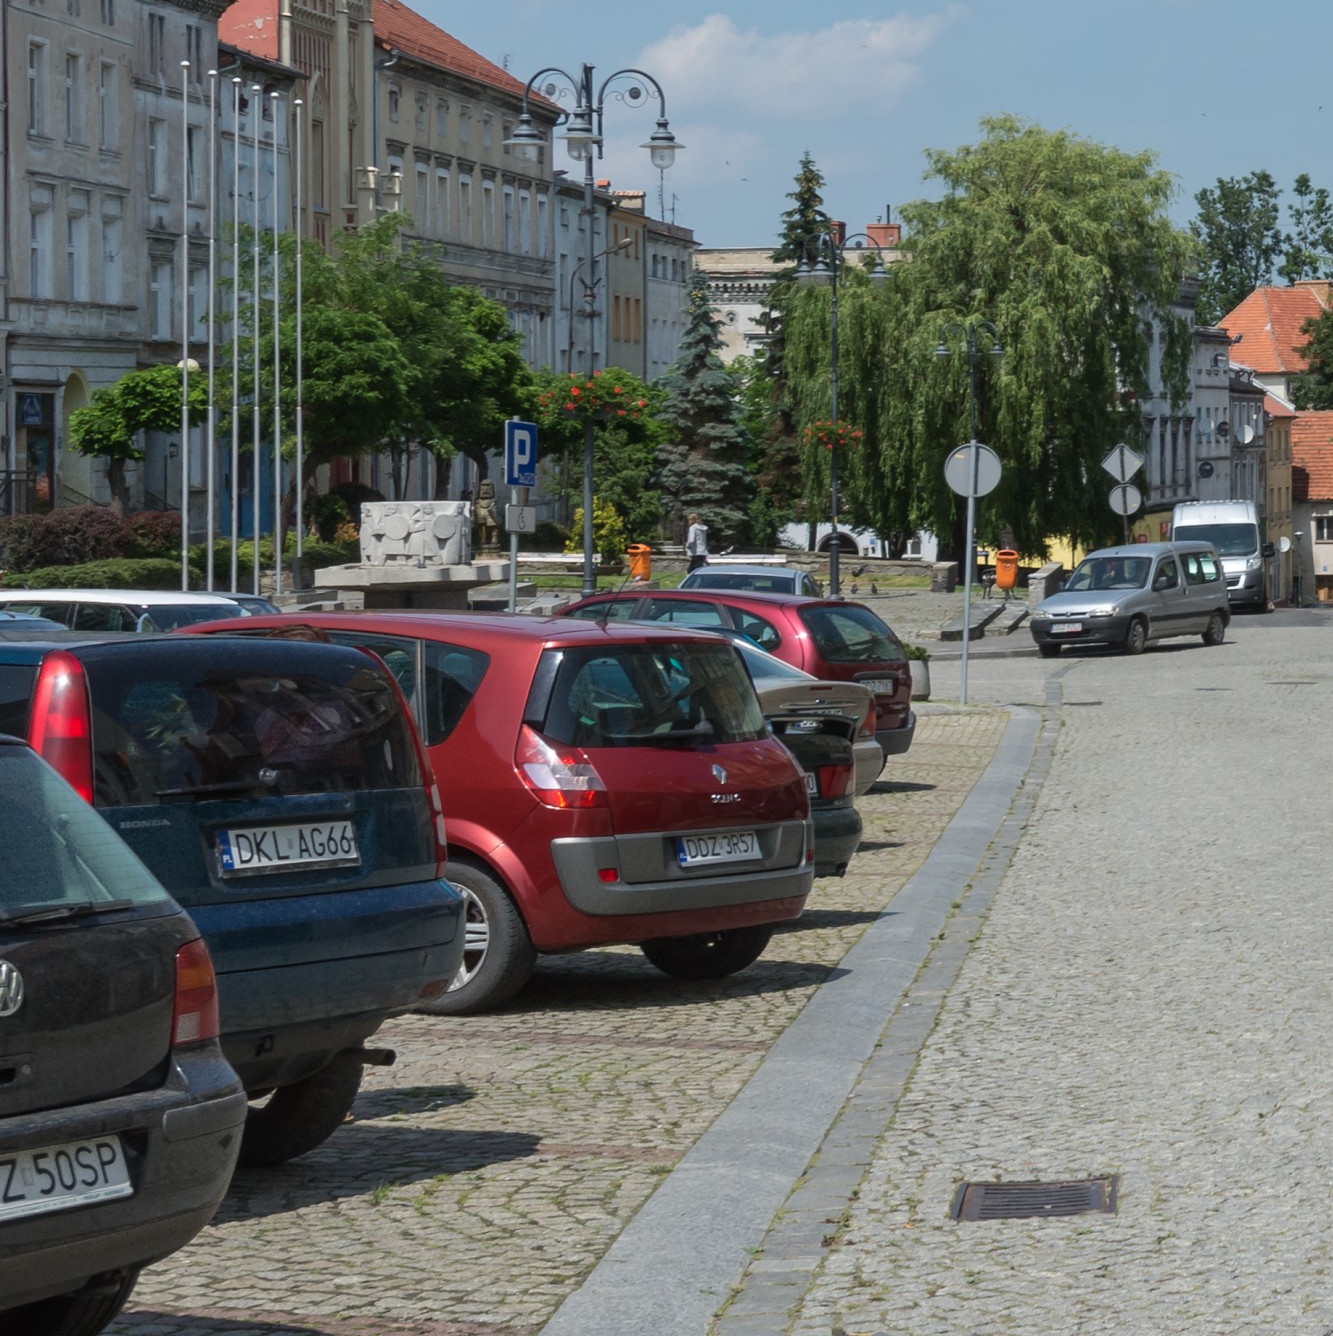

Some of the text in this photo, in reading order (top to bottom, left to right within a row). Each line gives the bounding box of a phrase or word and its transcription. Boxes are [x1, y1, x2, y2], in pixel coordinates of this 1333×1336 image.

[513, 429, 531, 479] P
[119, 818, 172, 829] HONDA
[235, 825, 352, 864] DKL AG66
[686, 833, 754, 859] DDZ 3R57
[32, 1142, 117, 1195] 50SP
